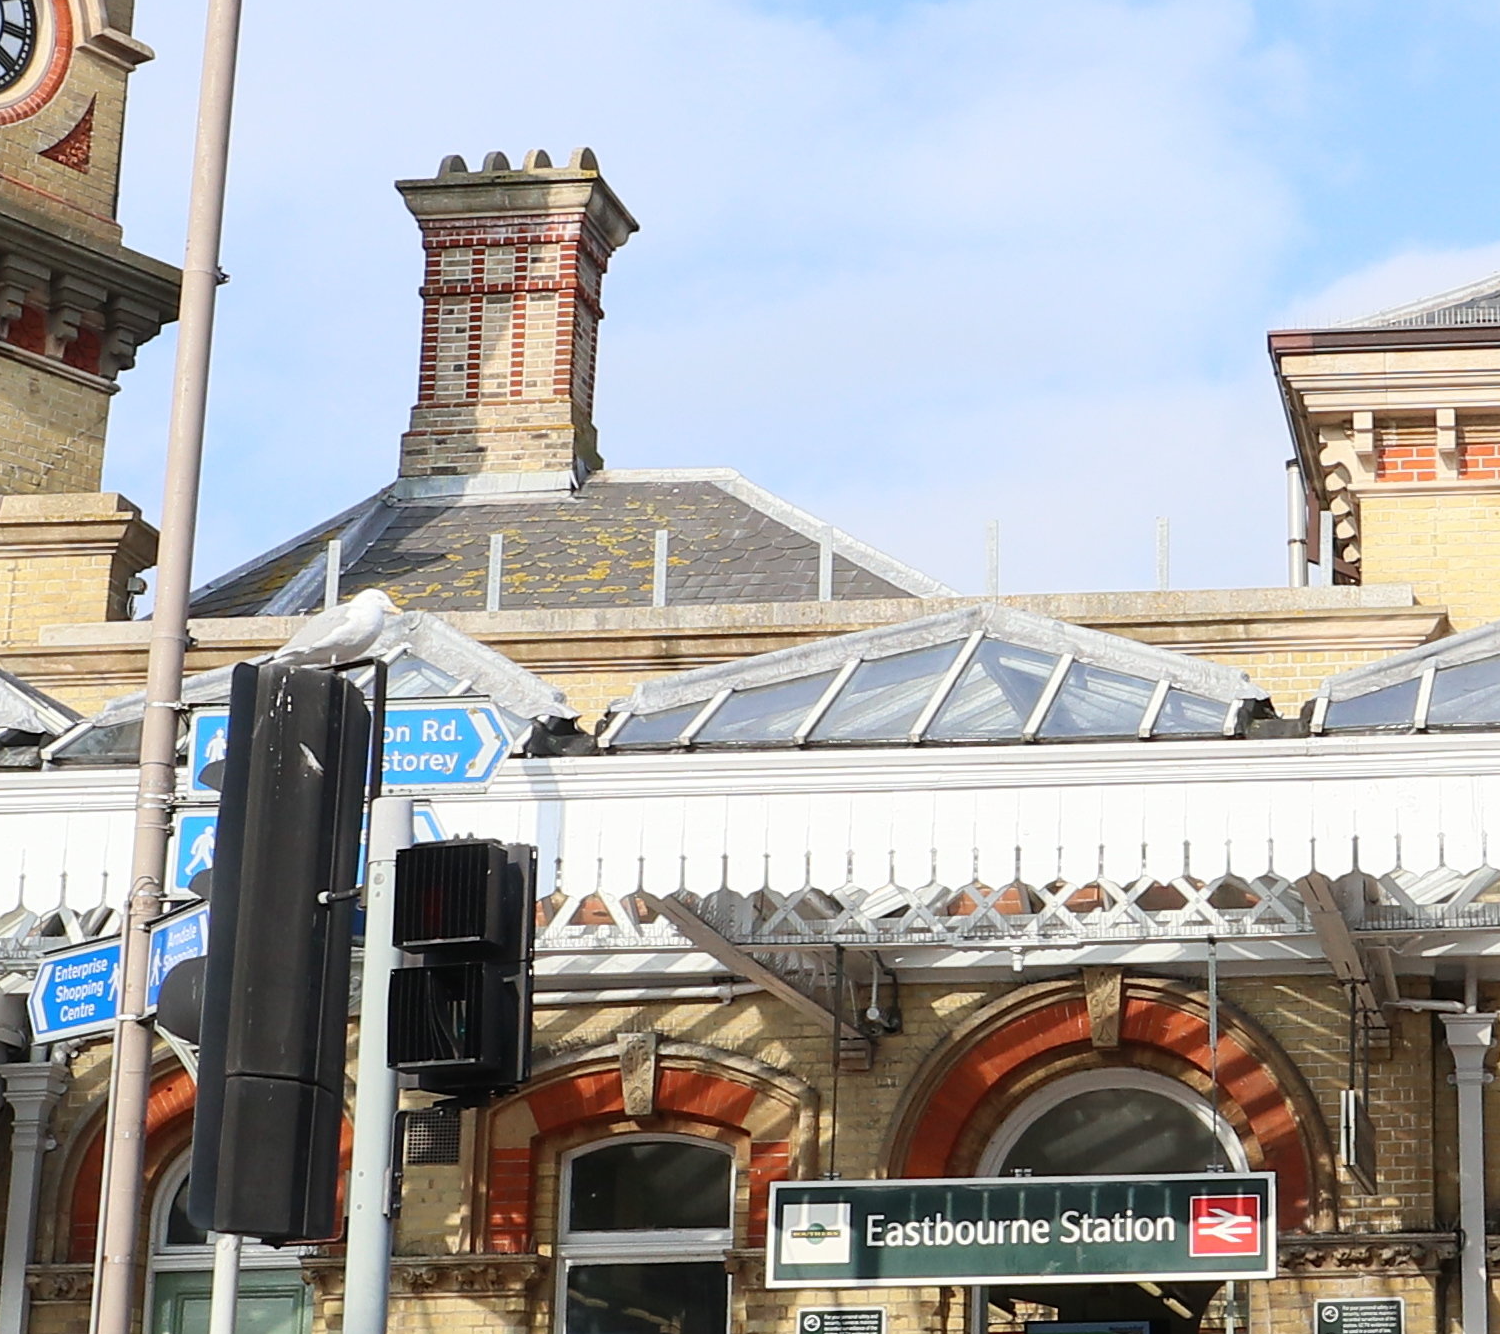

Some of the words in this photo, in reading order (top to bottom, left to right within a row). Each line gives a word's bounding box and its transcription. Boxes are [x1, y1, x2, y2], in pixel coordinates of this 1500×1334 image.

[383, 725, 411, 743] on
[422, 719, 463, 743] Rd.
[381, 750, 460, 774] storey
[54, 957, 109, 983] Enterprise
[55, 979, 105, 1003] Shopping
[60, 1002, 96, 1023] Centre
[866, 1213, 1050, 1247] Eastbourne
[1060, 1210, 1175, 1244] Station
